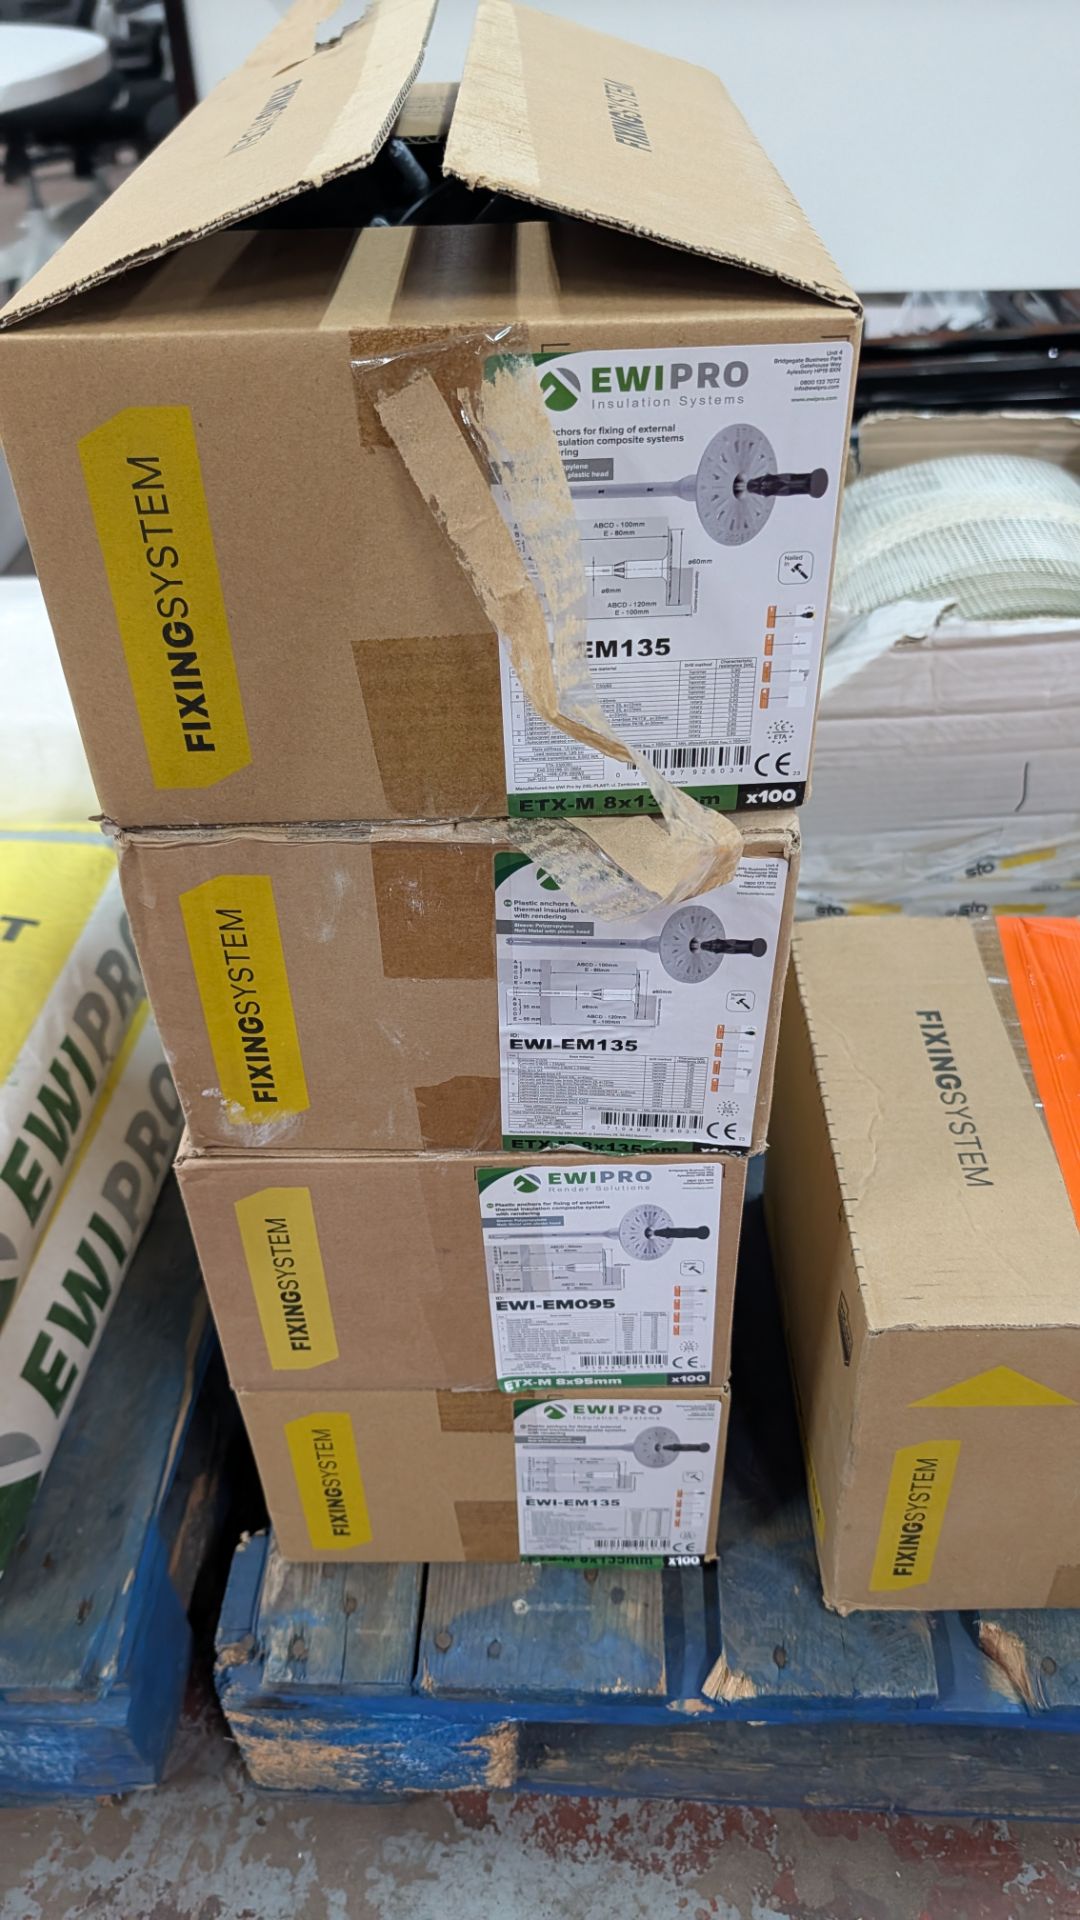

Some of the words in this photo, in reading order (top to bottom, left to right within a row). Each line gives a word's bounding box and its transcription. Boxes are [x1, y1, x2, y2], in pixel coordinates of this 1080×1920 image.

[591, 361, 749, 394] EWIPRO
[591, 396, 671, 410] Insulation
[679, 394, 745, 408] Systems
[553, 427, 582, 436] chors
[583, 427, 597, 435] for
[599, 426, 624, 436] fixing
[626, 425, 637, 434] of
[638, 424, 676, 434] external
[557, 438, 595, 447] sulation
[596, 436, 645, 446] composite
[646, 434, 685, 445] systems
[568, 470, 590, 479] plastic
[591, 470, 610, 478] head
[620, 521, 646, 529] 100mm
[126, 456, 216, 752] FIXINGSYSTEM
[626, 608, 650, 616] 100mm
[745, 788, 797, 804] x100
[519, 796, 595, 812] ETX-M
[965, 862, 996, 879] sto
[815, 904, 846, 917] sto
[215, 908, 279, 1103] FIXINGSYSTEM
[510, 1038, 638, 1052] EWI-EM135
[914, 1009, 995, 1187] FIXINGSYSTEM
[548, 1170, 653, 1185] EWIPRO
[548, 1185, 590, 1193] Render
[594, 1184, 651, 1192] Solutions
[264, 1217, 312, 1351] FIXINGSYSTEM
[496, 1298, 616, 1311] EWI-EM095
[504, 1378, 551, 1392] ETX-M
[556, 1376, 622, 1386] 8x95mm
[672, 1374, 706, 1383] x100
[572, 1404, 663, 1415] EWIPRO
[311, 1428, 350, 1537] FIXINGSYSTEM
[526, 1498, 620, 1507] EWI-EM135
[892, 1457, 939, 1577] FIXINGSYSTEM
[668, 1556, 700, 1566] x100
